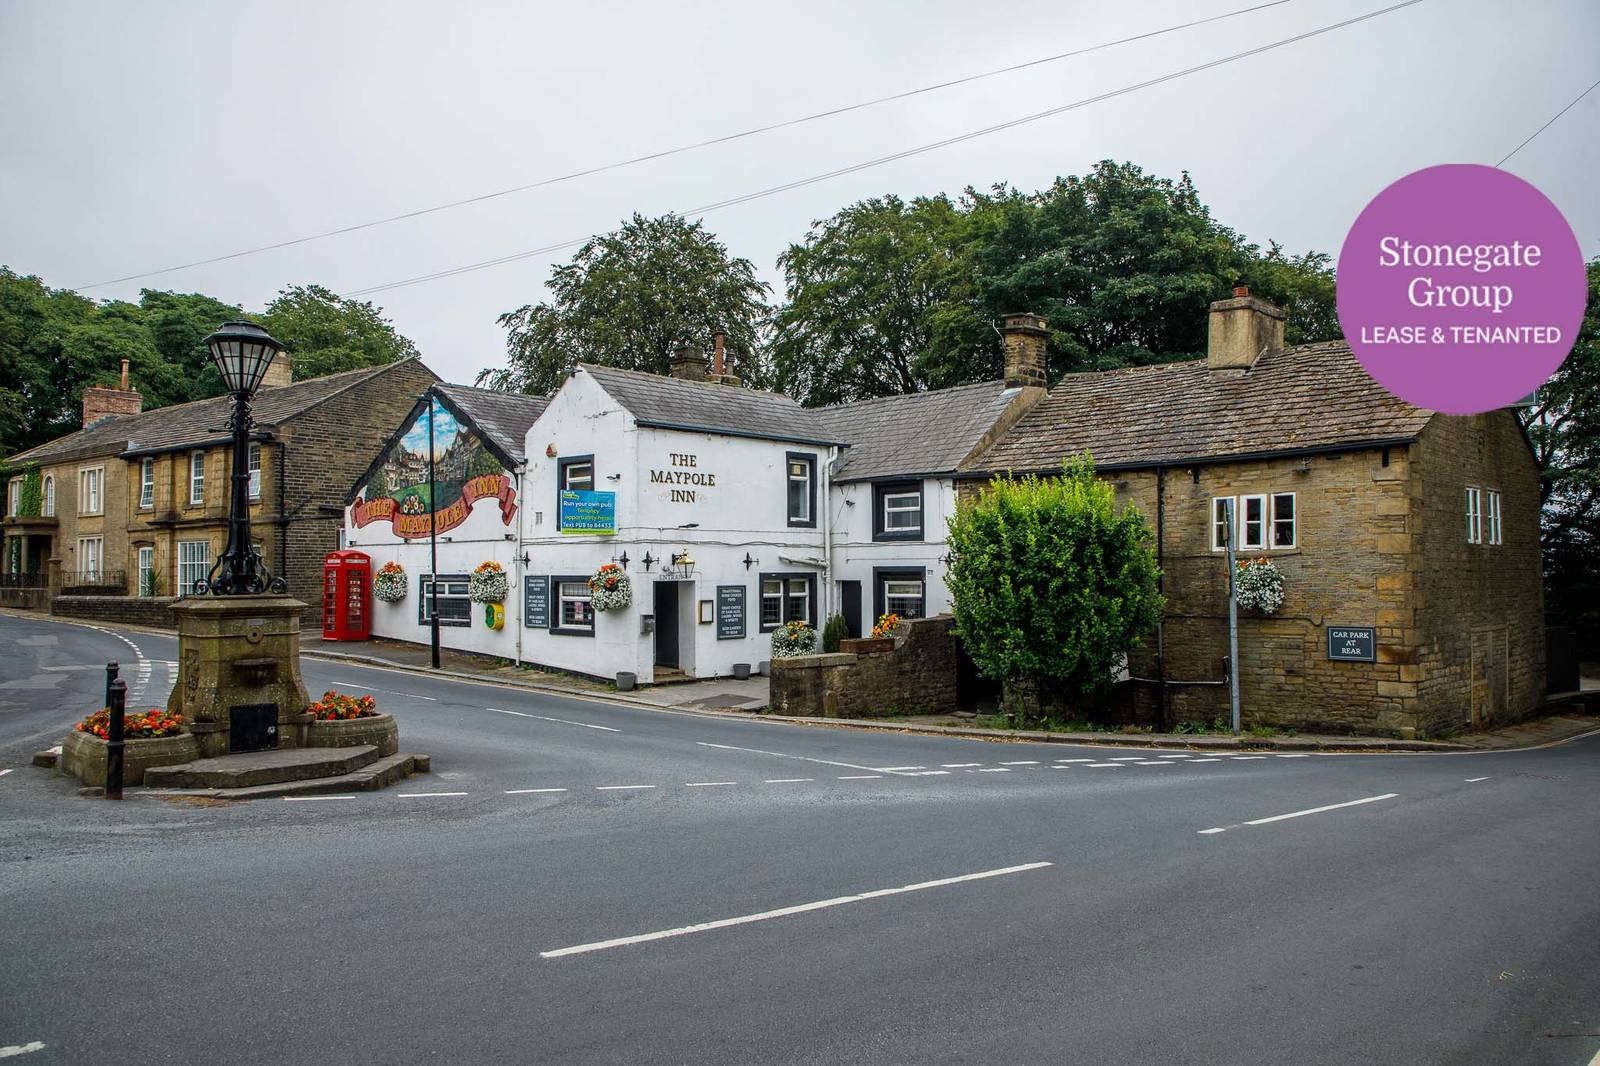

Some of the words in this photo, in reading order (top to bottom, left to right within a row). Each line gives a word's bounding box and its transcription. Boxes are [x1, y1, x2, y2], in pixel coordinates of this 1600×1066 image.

[669, 453, 697, 467] THE
[650, 470, 716, 487] MAYPOLE
[365, 501, 391, 518] THE
[471, 478, 501, 496] INN
[670, 489, 697, 503] INN
